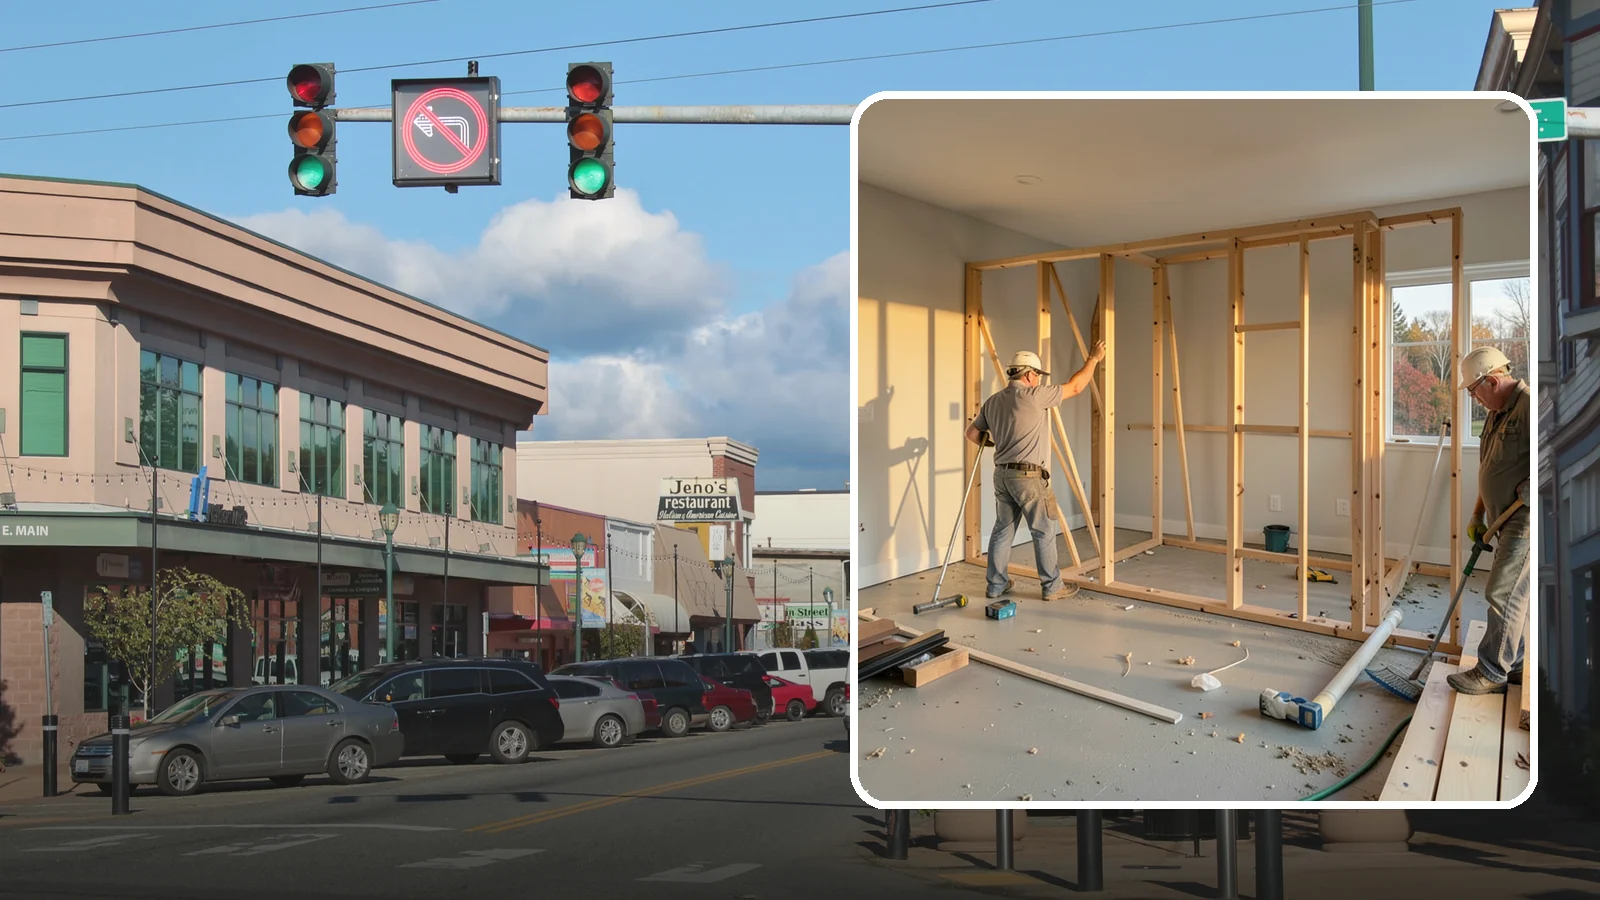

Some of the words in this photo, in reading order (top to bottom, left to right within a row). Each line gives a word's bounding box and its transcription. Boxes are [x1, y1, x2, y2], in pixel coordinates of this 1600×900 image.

[669, 480, 727, 495] Jeno's
[665, 496, 731, 509] restaurant
[658, 509, 681, 520] Italian
[685, 509, 714, 519] American
[715, 509, 738, 519] Cuisine
[2, 525, 13, 536] E.
[15, 525, 49, 536] MAIN
[797, 607, 828, 617] Street
